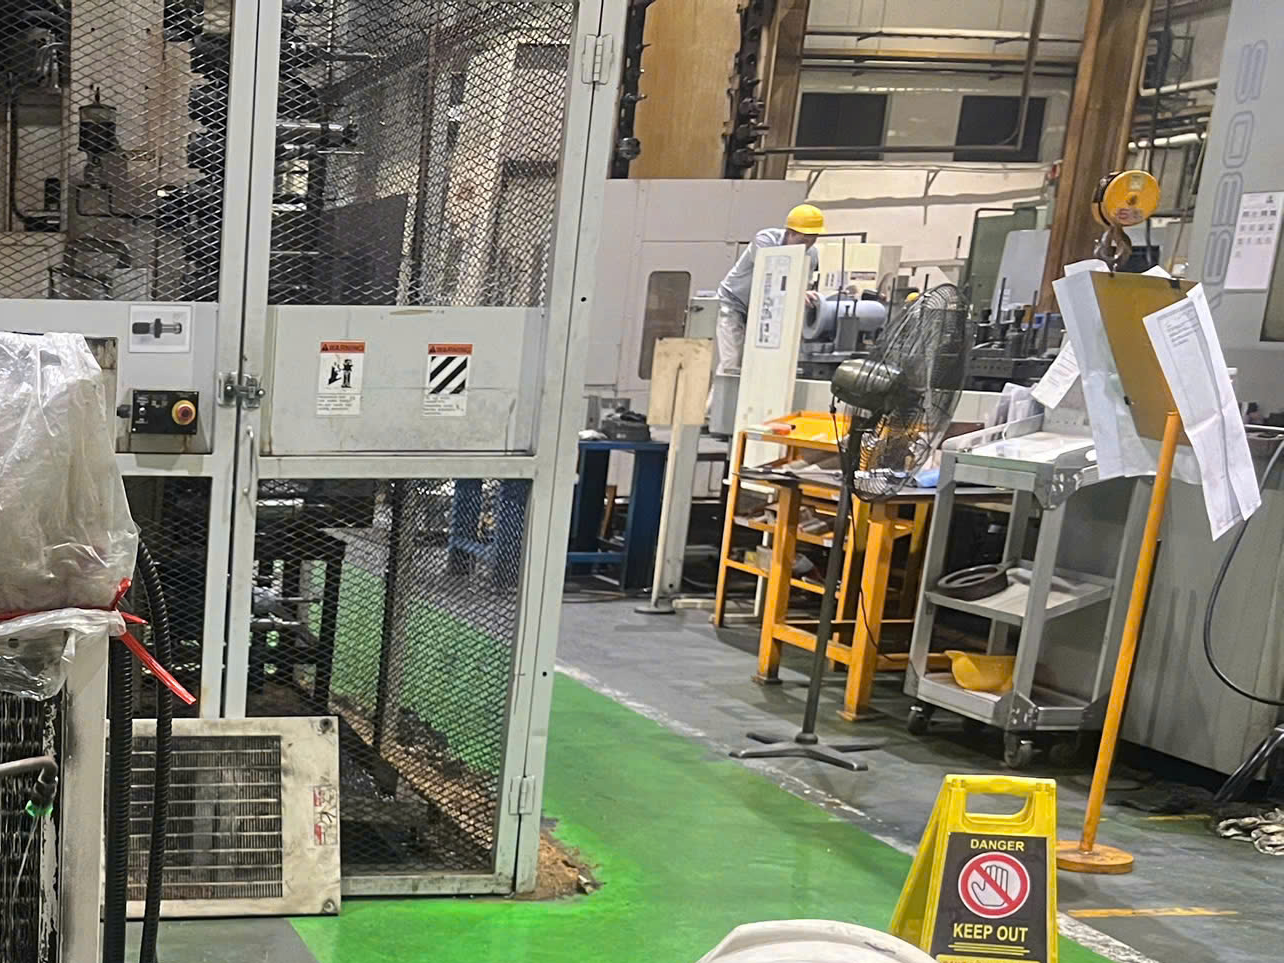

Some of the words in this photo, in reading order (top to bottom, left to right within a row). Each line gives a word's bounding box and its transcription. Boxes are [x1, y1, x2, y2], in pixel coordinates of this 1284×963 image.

[970, 838, 1025, 852] DANGER
[953, 923, 993, 939] KEEP
[996, 925, 1028, 943] OUT
